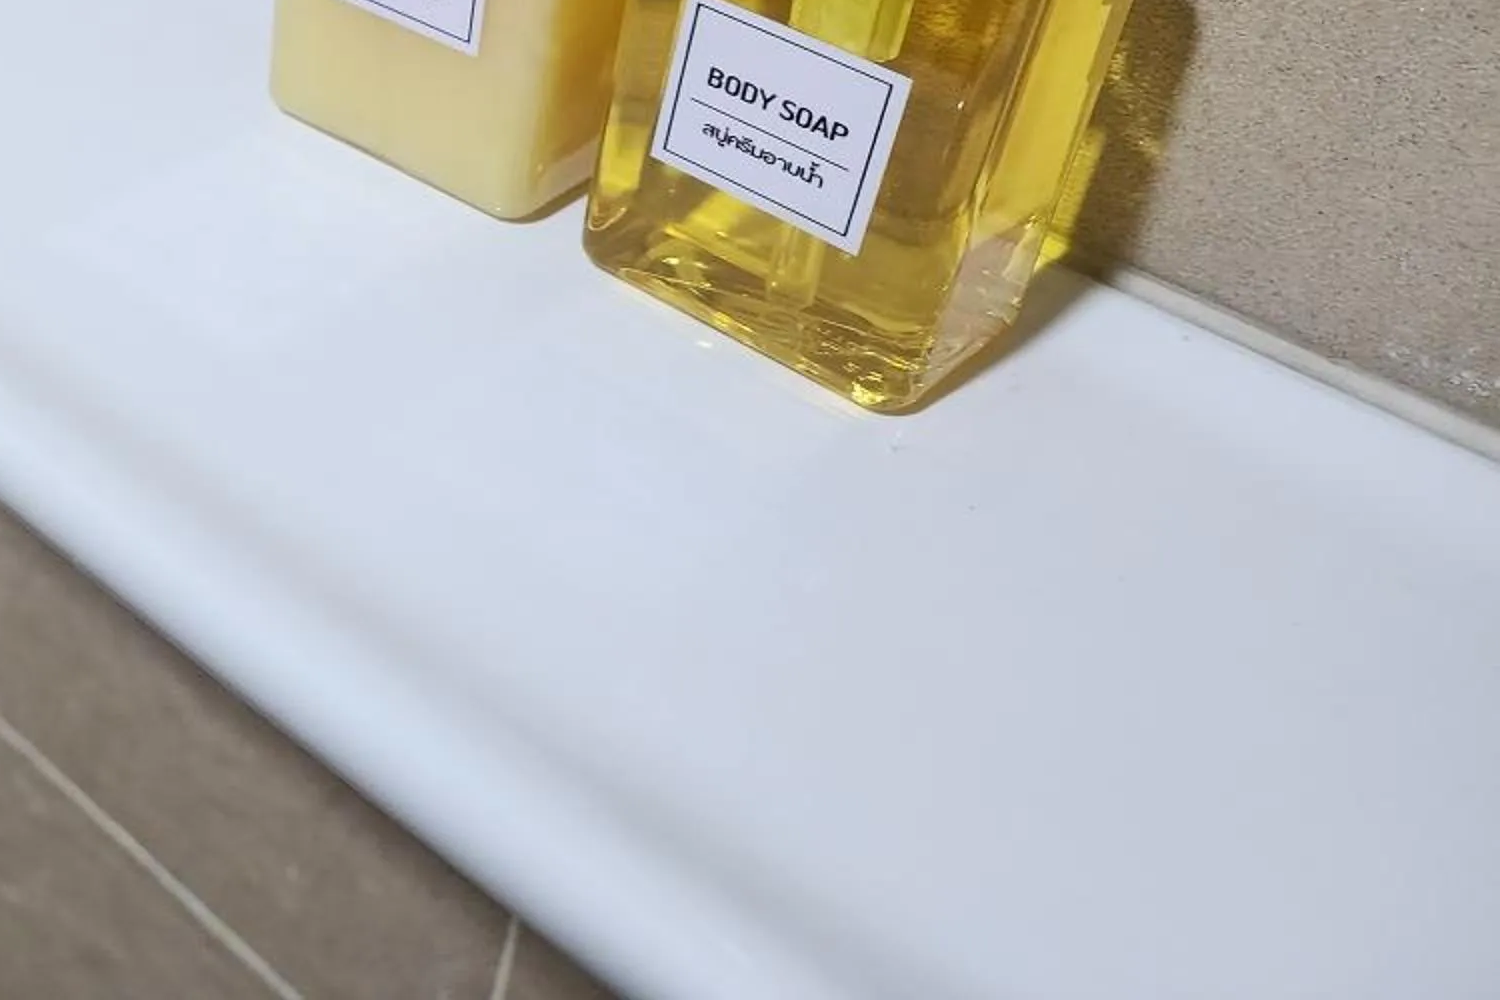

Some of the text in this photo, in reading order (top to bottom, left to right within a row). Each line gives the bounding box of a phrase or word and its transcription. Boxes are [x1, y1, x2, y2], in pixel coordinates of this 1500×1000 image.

[706, 66, 850, 142] BODY SOAP
[701, 122, 824, 189] สบู่ครีมอาบน้ำ
